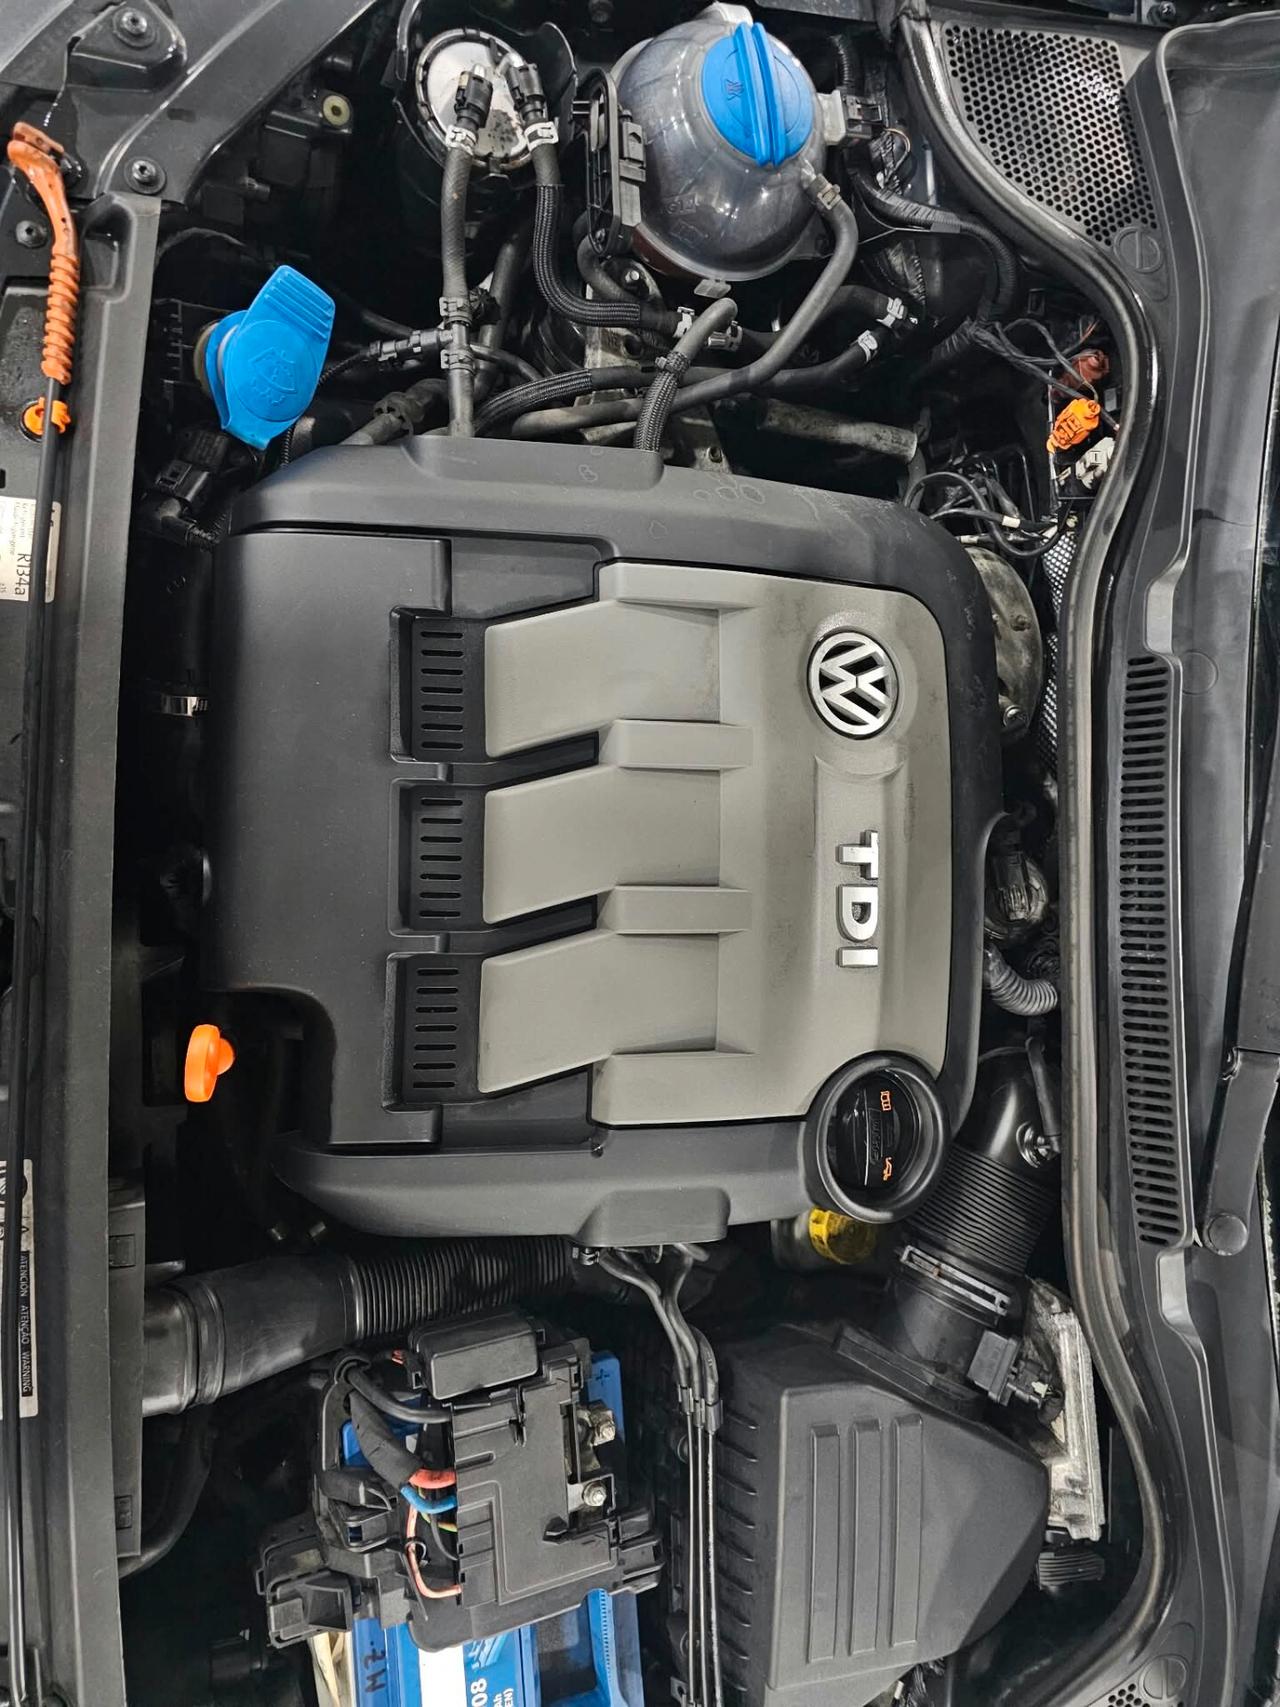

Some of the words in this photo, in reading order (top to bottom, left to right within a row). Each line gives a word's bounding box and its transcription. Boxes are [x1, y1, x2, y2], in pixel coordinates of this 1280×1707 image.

[15, 553, 31, 596] R134a
[808, 631, 898, 739] VW
[836, 830, 879, 968] TDI
[22, 1351, 32, 1392] WARNING
